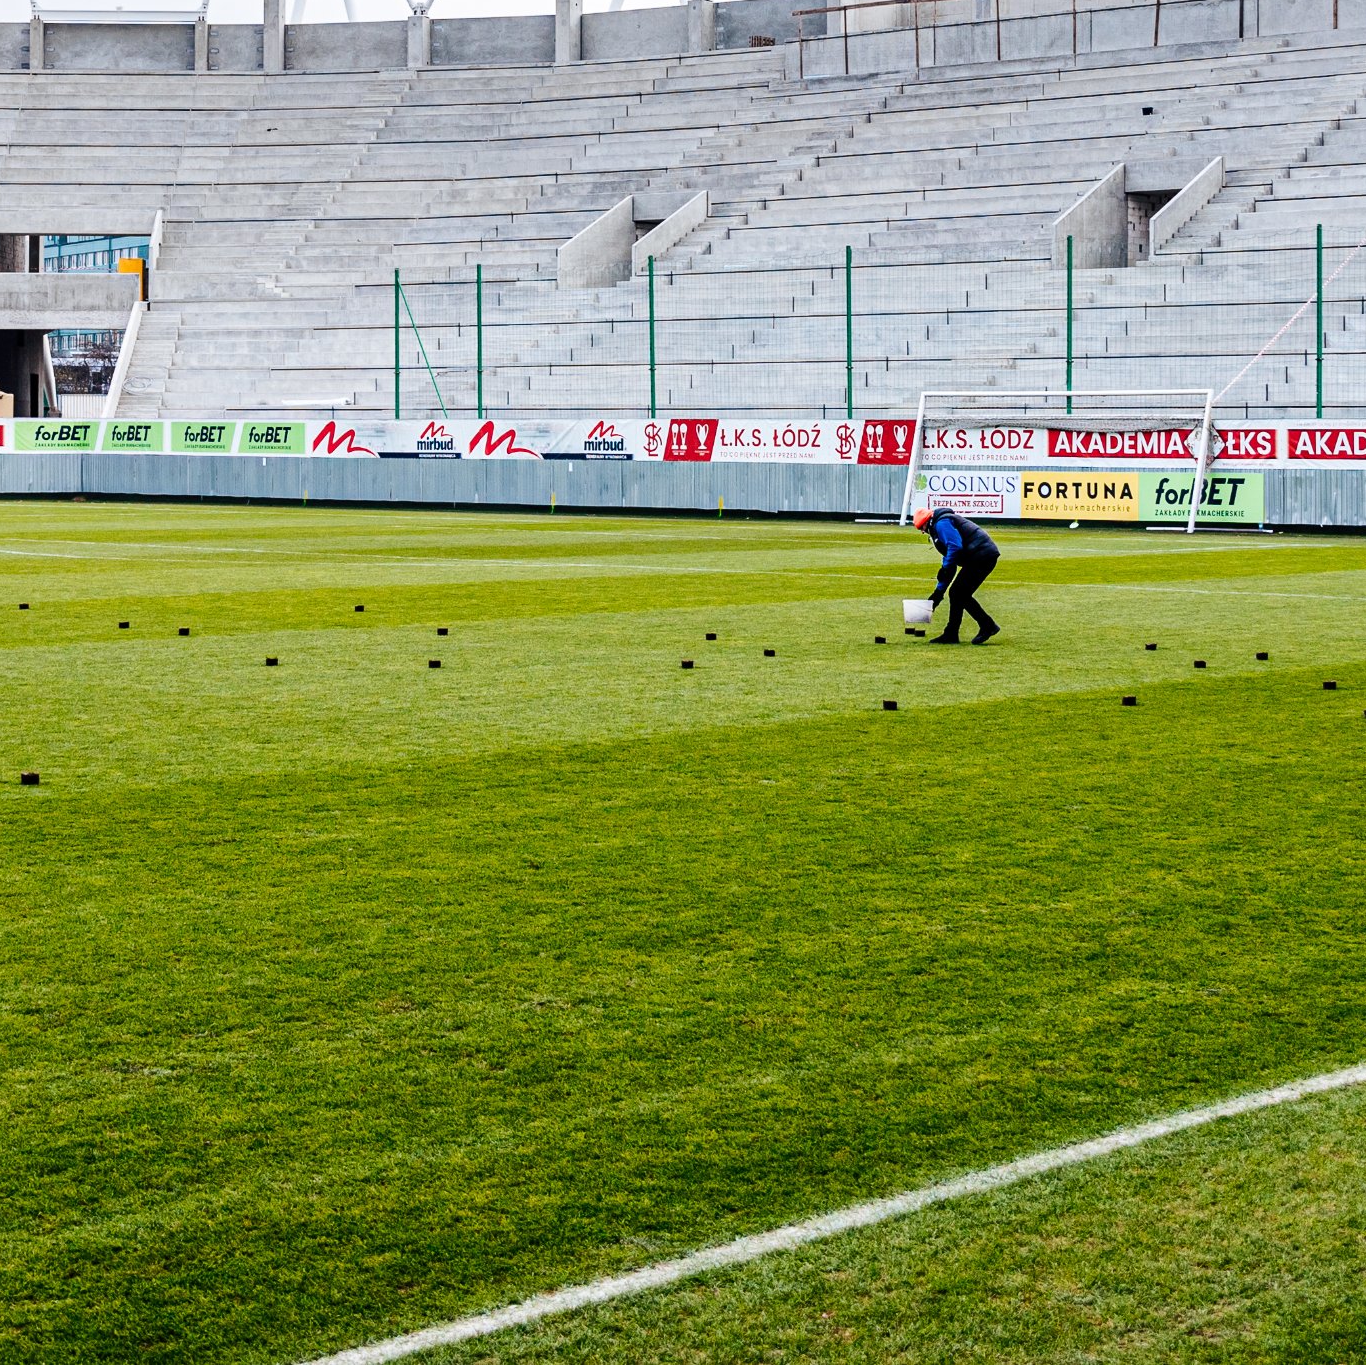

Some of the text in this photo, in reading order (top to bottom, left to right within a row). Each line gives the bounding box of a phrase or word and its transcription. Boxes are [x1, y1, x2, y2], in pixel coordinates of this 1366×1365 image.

[35, 425, 91, 441] forBET
[112, 425, 152, 442] forBET
[184, 425, 226, 443] forBET
[248, 426, 292, 443] forBET
[720, 423, 821, 447] Ł.K.S. ŁÓDŹ
[417, 437, 453, 450] mirbud
[583, 437, 624, 452] mirbud
[1054, 431, 1272, 456] AKADEMIA ŁKS
[928, 475, 1016, 493] COSINUS
[1023, 481, 1133, 499] FORTUNA
[933, 500, 999, 508] BEZPŁATNE SZKOŁY
[1025, 503, 1131, 512] zakłady bukmacherskie
